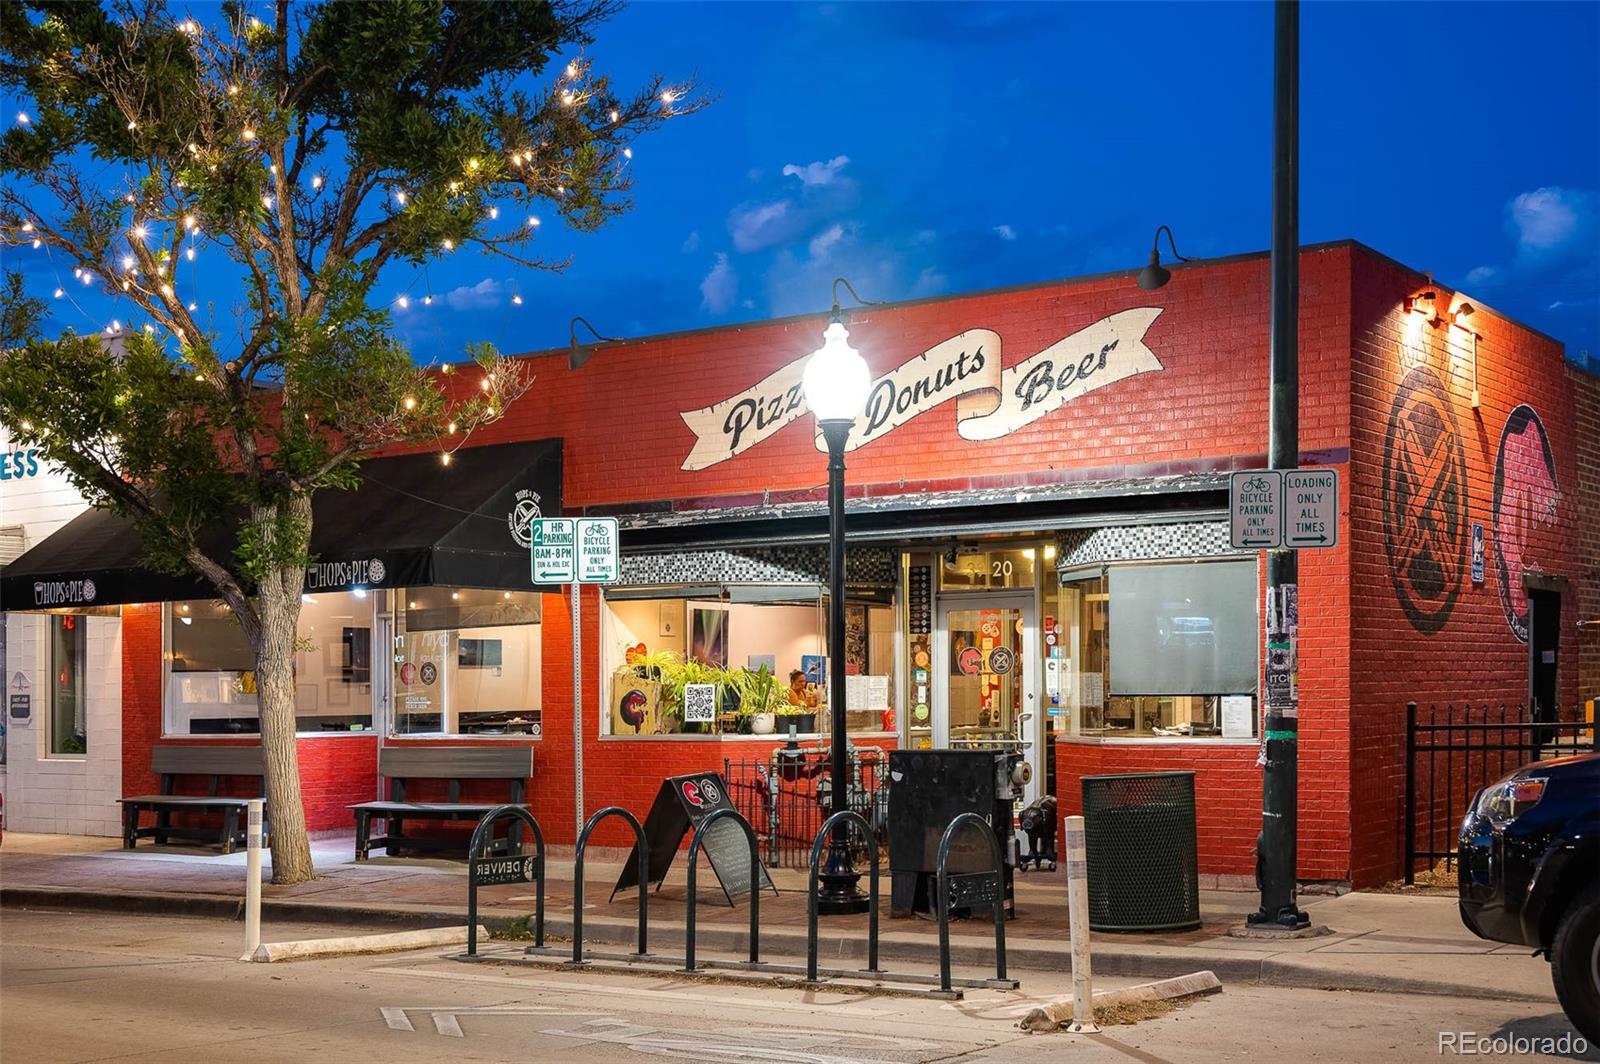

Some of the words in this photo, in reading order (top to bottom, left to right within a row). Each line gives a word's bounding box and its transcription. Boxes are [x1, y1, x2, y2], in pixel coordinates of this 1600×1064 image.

[723, 382, 807, 450] Pizz
[863, 345, 985, 436] Donuts
[1015, 338, 1119, 411] Beer
[1288, 477, 1332, 488] LOADING
[1240, 493, 1273, 503] BICYCLE
[1297, 493, 1323, 504] ONLY
[1240, 505, 1274, 515] PARKING
[1301, 508, 1319, 519] ALL
[551, 522, 564, 532] HR
[1247, 518, 1265, 526] ONLY
[1257, 528, 1274, 536] TIMES
[1296, 522, 1325, 533] TIMES
[534, 524, 542, 542] 2
[543, 533, 573, 543] PARKING
[583, 536, 610, 545] BICYCLE
[583, 547, 611, 555] PARKING
[590, 557, 605, 565] ONLY
